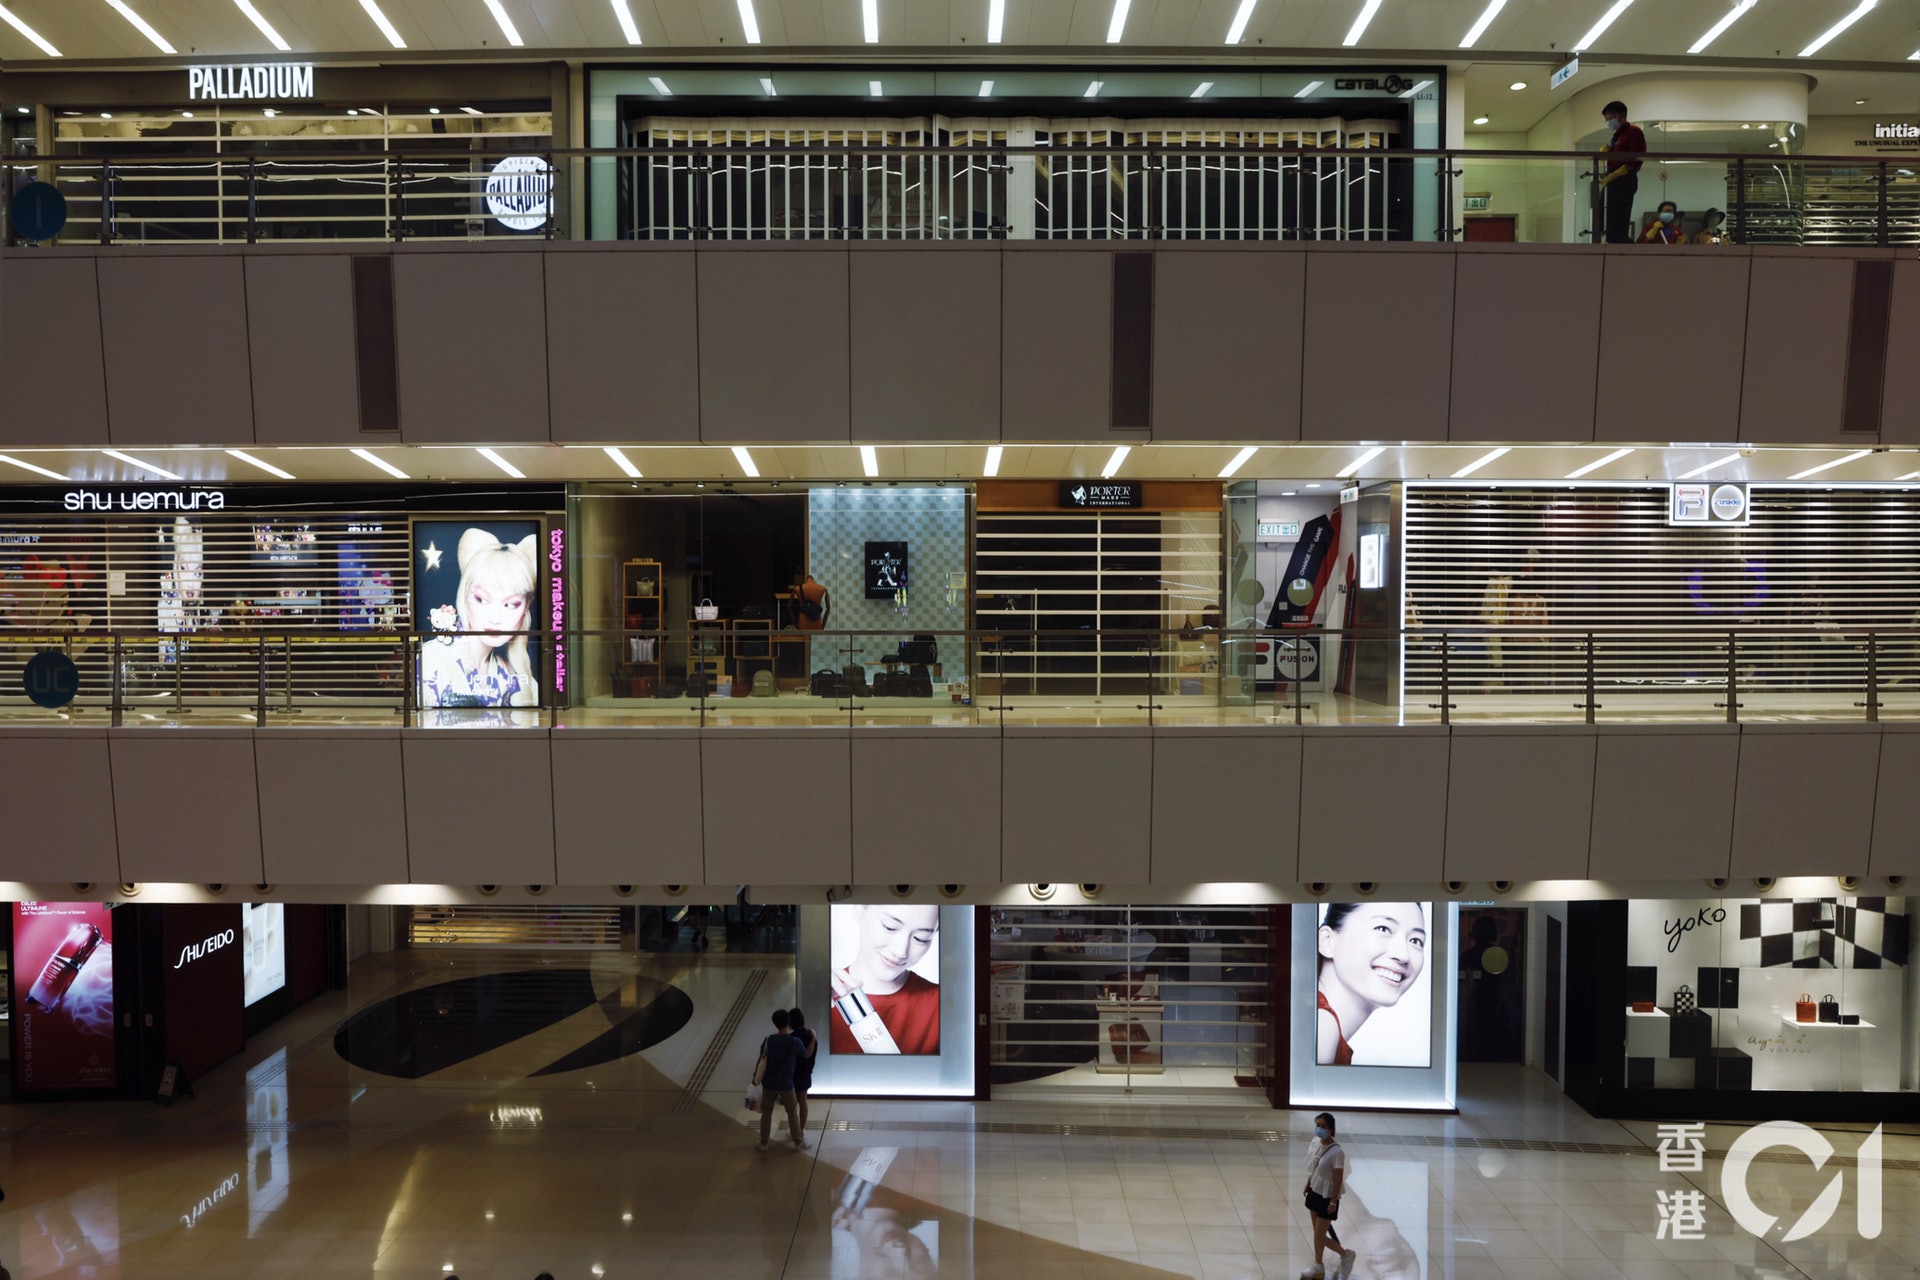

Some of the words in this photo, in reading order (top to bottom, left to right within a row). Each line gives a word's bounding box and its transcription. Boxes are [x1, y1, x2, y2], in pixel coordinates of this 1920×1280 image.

[189, 66, 314, 99] PALLADIUM
[1875, 123, 1920, 138] initia
[489, 172, 551, 214] PALLADIU
[64, 490, 112, 510] shu
[121, 489, 224, 509] uemura
[1090, 485, 1131, 496] PORTER
[1260, 524, 1281, 535] EXIT
[550, 529, 564, 573] tokyo
[1299, 554, 1312, 576] CHANGE
[1313, 527, 1324, 543] GAME
[1280, 655, 1315, 663] FUSON
[173, 928, 234, 969] SHISEIDO
